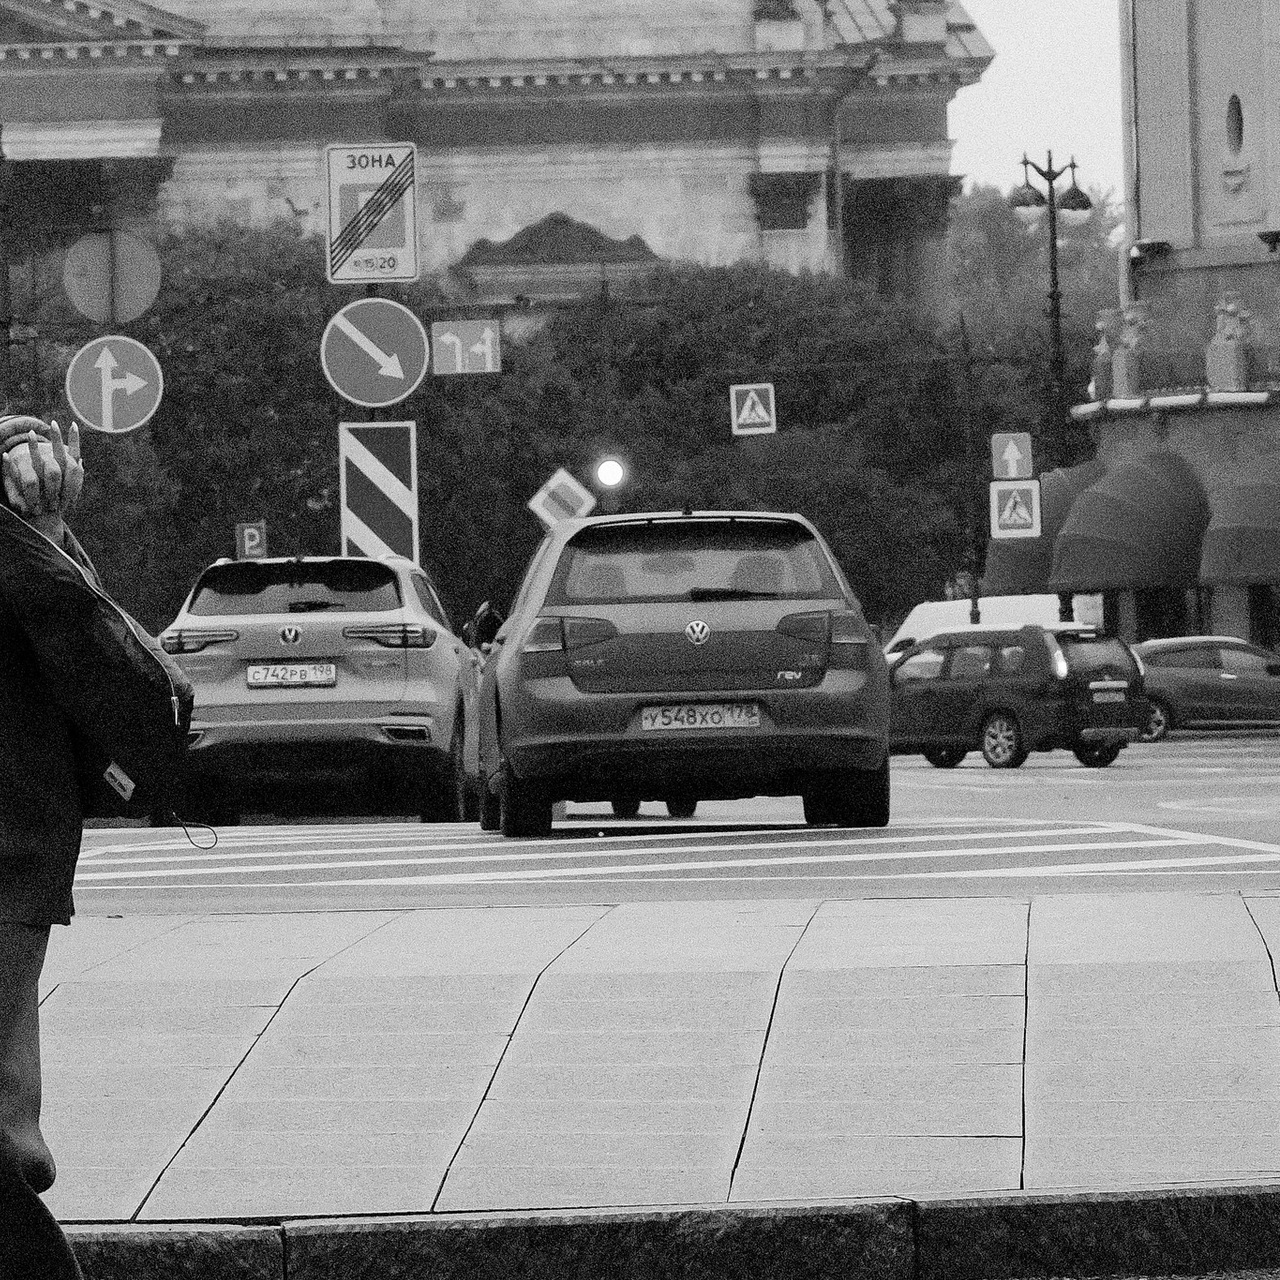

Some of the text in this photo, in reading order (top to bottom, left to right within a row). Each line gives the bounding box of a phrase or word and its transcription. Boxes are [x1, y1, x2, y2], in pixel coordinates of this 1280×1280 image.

[346, 153, 396, 169] ЗОНА
[379, 256, 396, 269] 20
[243, 528, 260, 556] P
